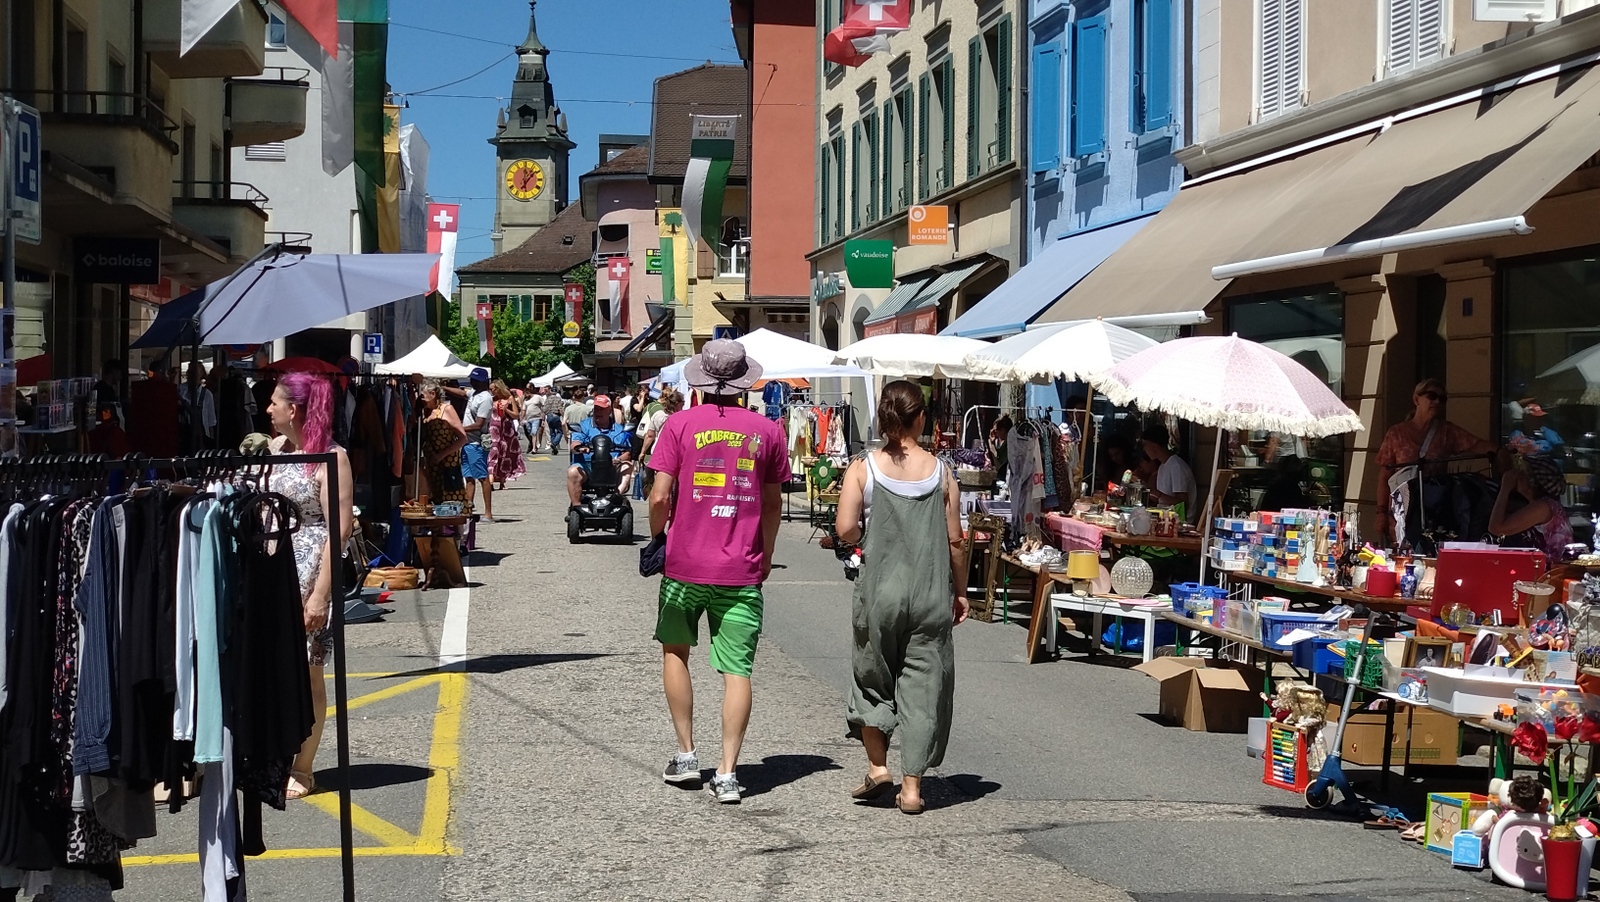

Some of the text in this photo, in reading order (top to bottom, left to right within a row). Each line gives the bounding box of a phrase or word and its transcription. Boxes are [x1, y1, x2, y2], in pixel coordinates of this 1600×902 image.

[99, 253, 152, 267] baloise
[367, 336, 376, 351] P
[693, 430, 748, 451] ZICABRET!
